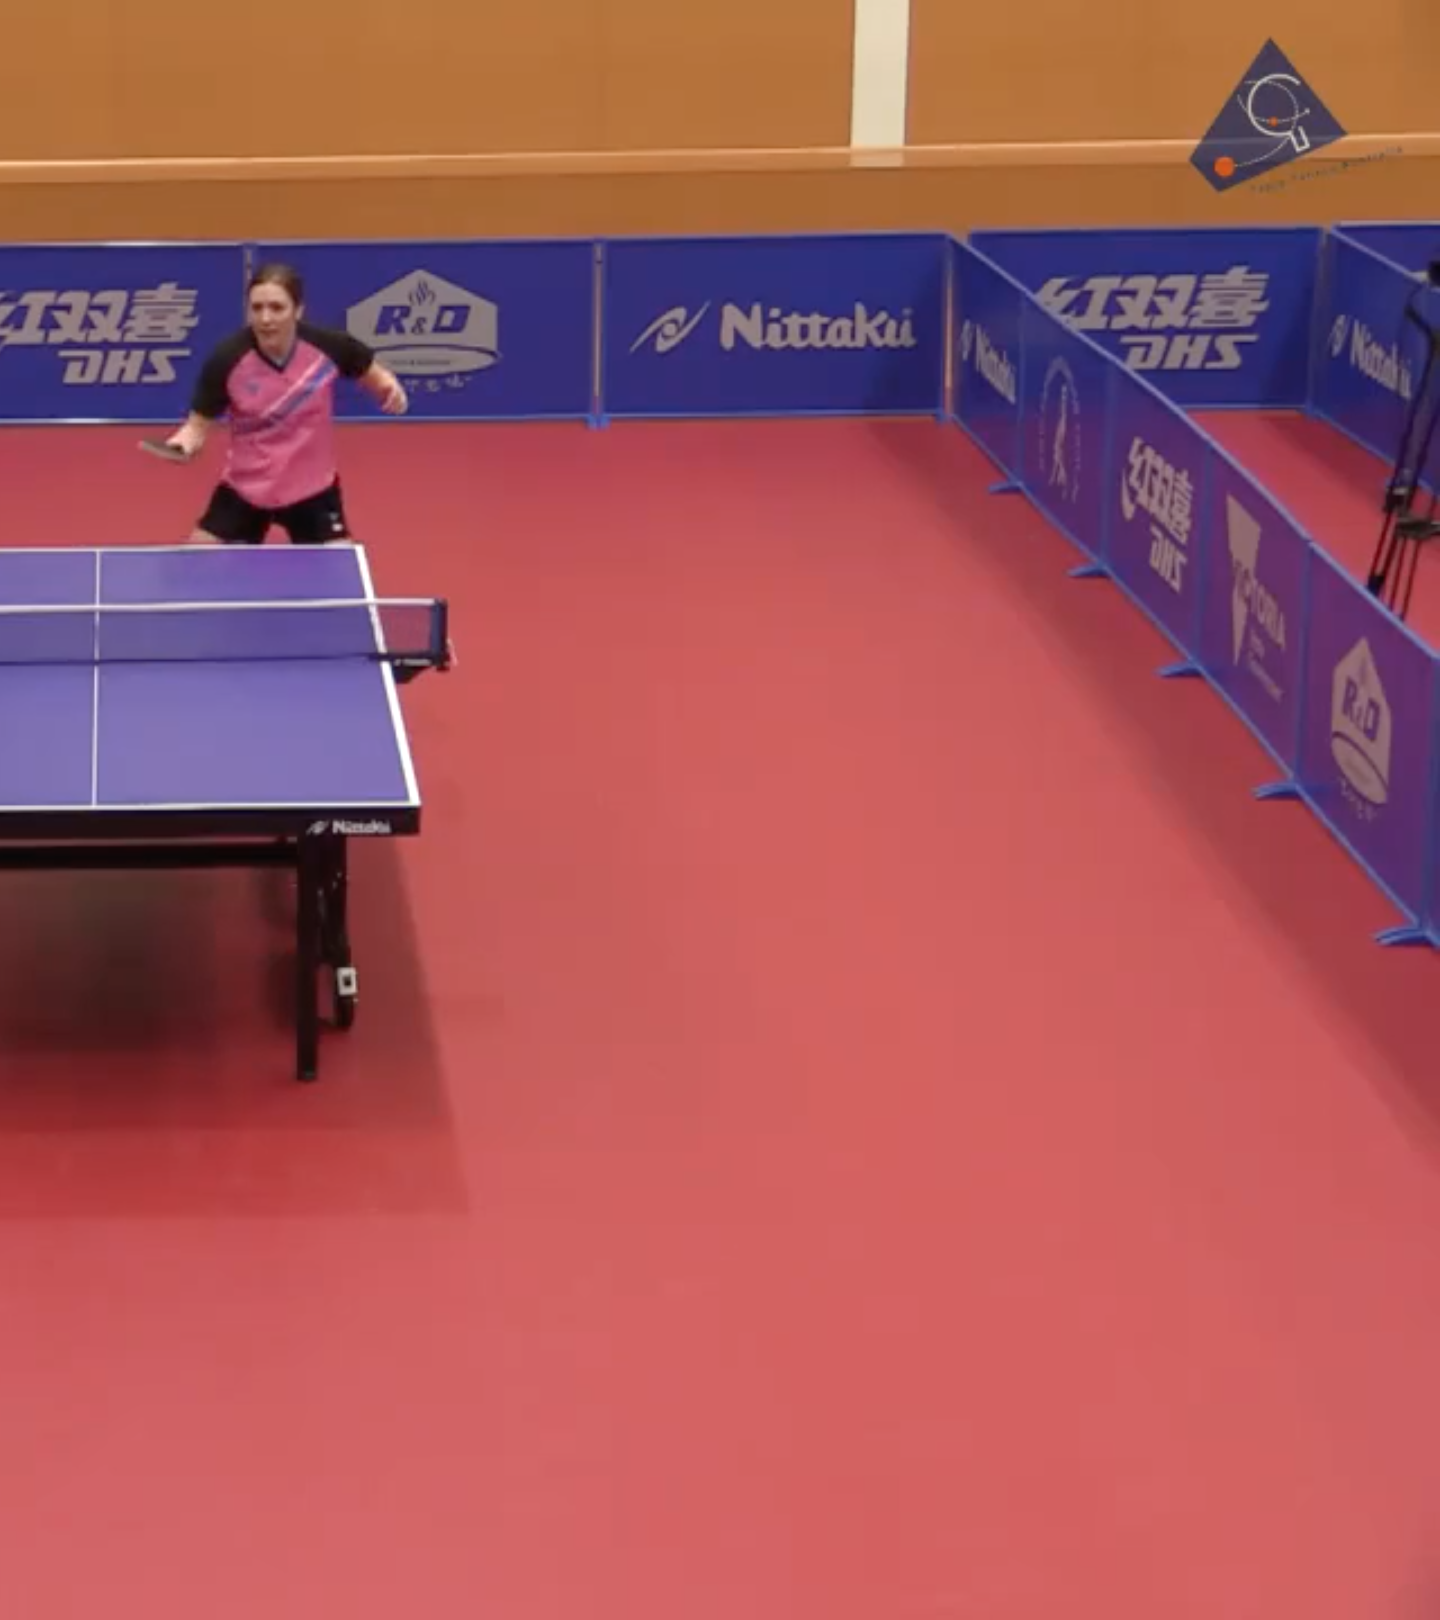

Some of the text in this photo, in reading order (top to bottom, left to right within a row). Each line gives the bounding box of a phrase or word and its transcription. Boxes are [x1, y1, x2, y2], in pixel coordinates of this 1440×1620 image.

[375, 304, 471, 336] R&D
[720, 301, 917, 351] Nittaku
[58, 349, 192, 385] DHS
[1119, 334, 1259, 370] DHS
